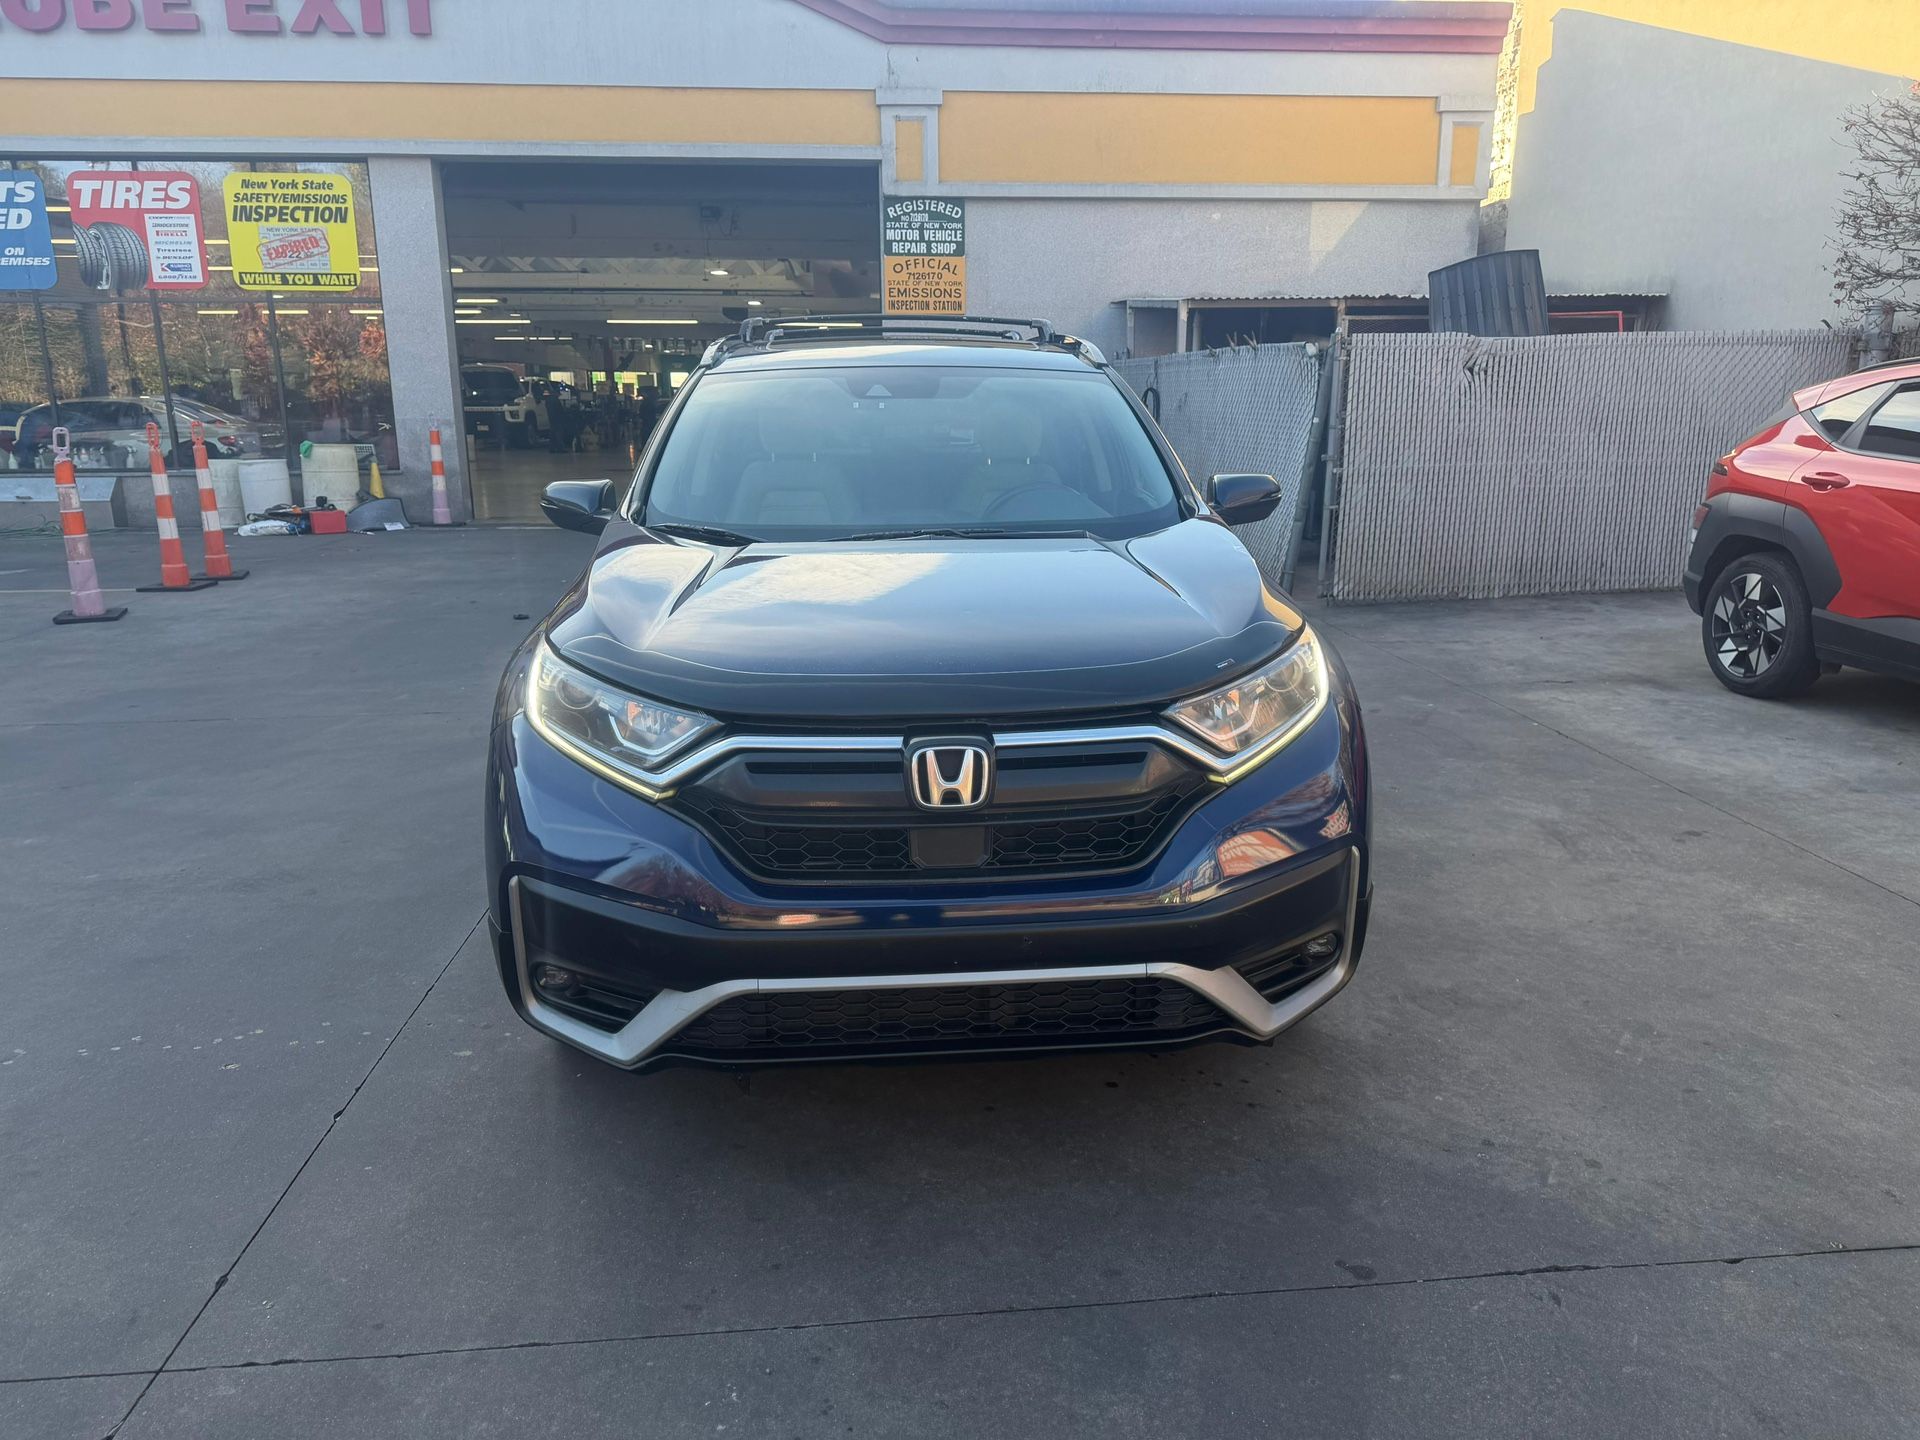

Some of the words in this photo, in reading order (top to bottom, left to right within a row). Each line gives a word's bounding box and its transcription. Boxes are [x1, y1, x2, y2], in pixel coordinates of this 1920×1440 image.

[241, 179, 267, 189] New
[270, 179, 299, 190] York
[302, 180, 334, 190] State
[73, 180, 191, 209] TIRES
[233, 192, 348, 204] SAFETY/EMISSIONS
[232, 205, 349, 223] INSPECTION
[887, 199, 962, 219] REGISTERED
[0, 208, 33, 230] D
[886, 229, 920, 241] MOTOR
[923, 230, 963, 242] VEHICLE
[4, 247, 25, 256] ON
[892, 242, 927, 254] REPAIR
[931, 243, 957, 254] SHOP
[0, 257, 50, 266] EMISES
[892, 258, 958, 276] OFFICIAL
[241, 273, 282, 285] WHILE
[285, 274, 314, 285] YOU
[317, 274, 356, 286] WAIT!
[906, 272, 943, 281] 7126170
[888, 287, 962, 299] EMISSIONS
[888, 300, 930, 311] INSPECTION
[933, 300, 963, 311] STATION
